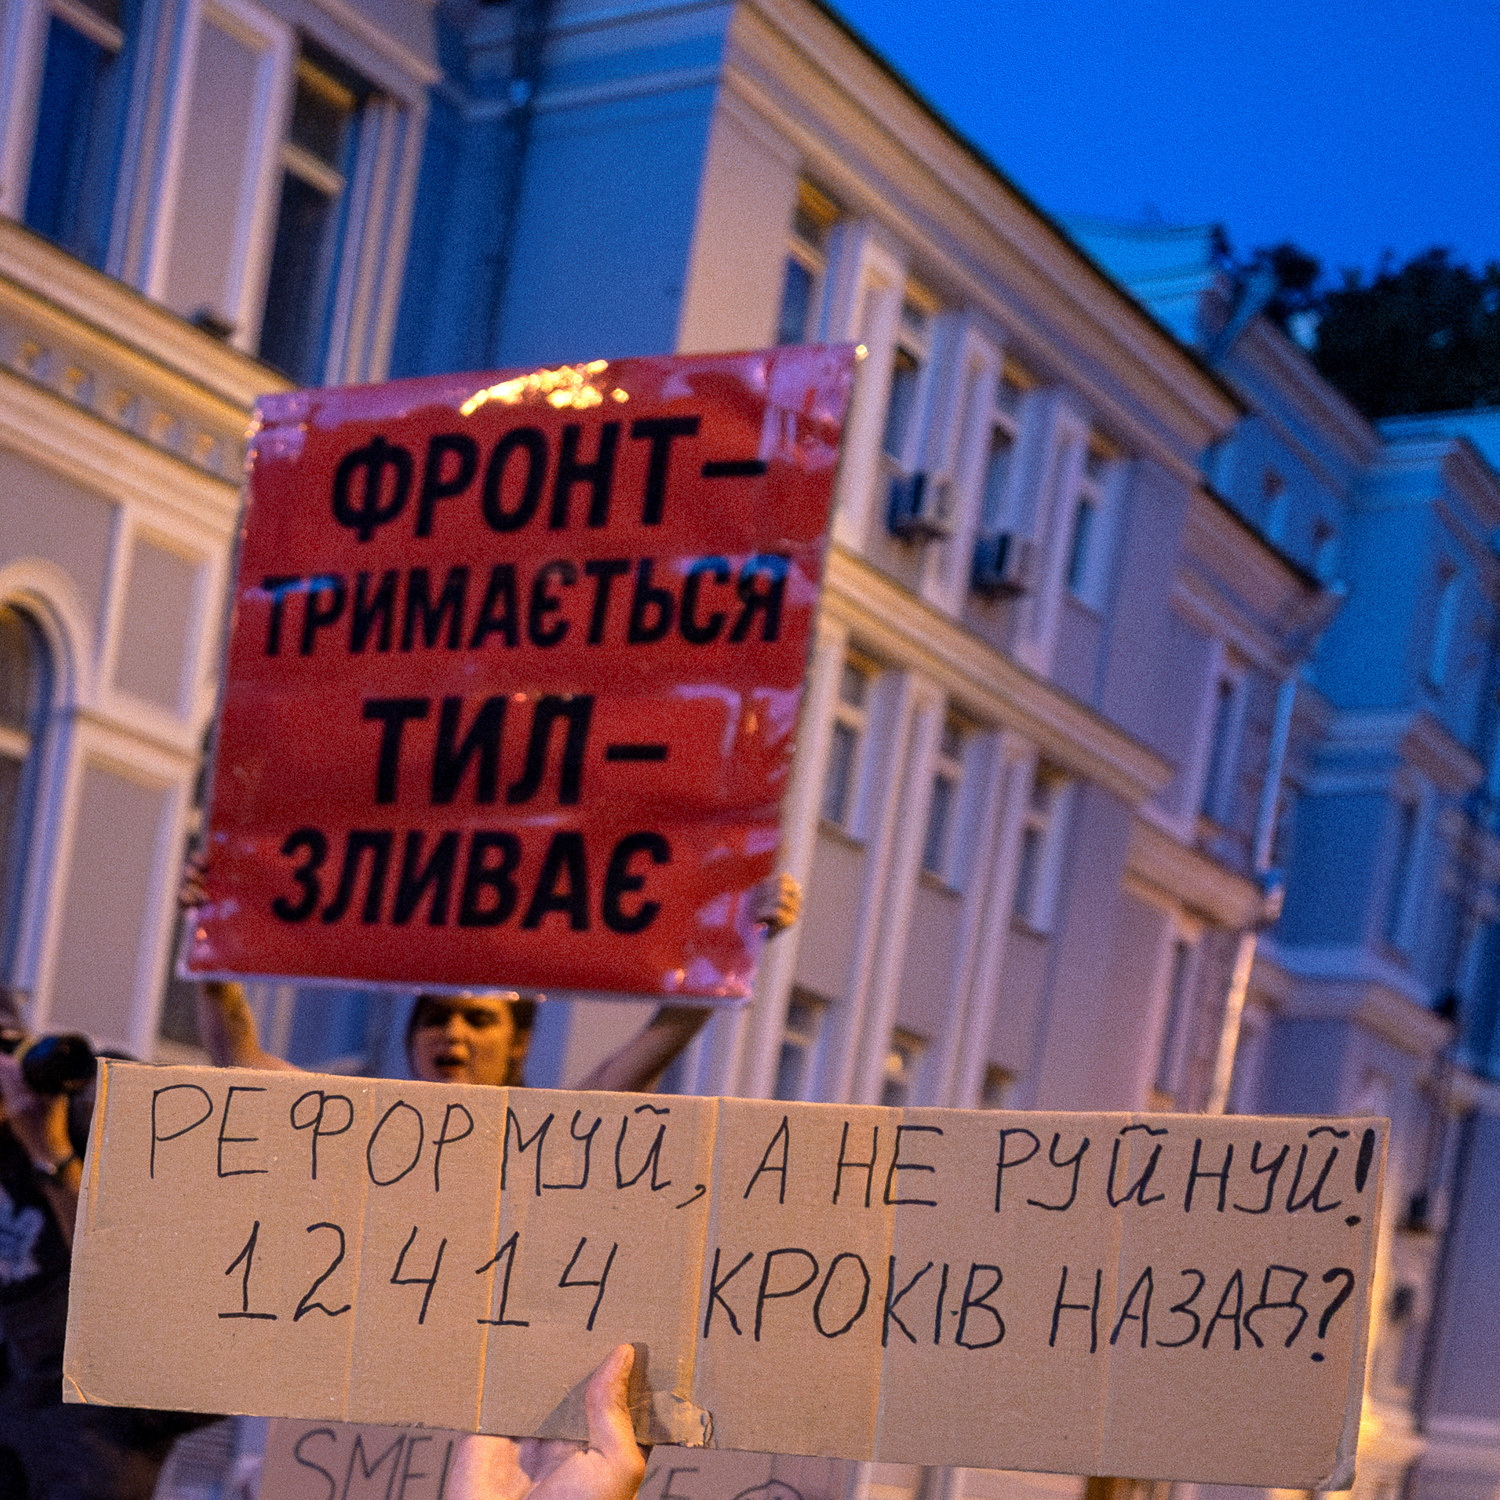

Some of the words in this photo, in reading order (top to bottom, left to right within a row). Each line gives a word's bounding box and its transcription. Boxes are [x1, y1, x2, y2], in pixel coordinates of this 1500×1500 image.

[261, 554, 789, 656] ТРИМАЄТЬСЯ
[272, 829, 671, 933] ЗЛИВАЄ
[151, 1084, 706, 1209] РЕФОРМУЙ,
[744, 1115, 789, 1204] А
[834, 1122, 943, 1208] НЕ
[995, 1124, 1376, 1226] РУЙНУЙ!
[217, 1220, 618, 1330] 12414
[702, 1247, 1006, 1349] КРОКІВ
[1048, 1265, 1355, 1362] НАЗАД?
